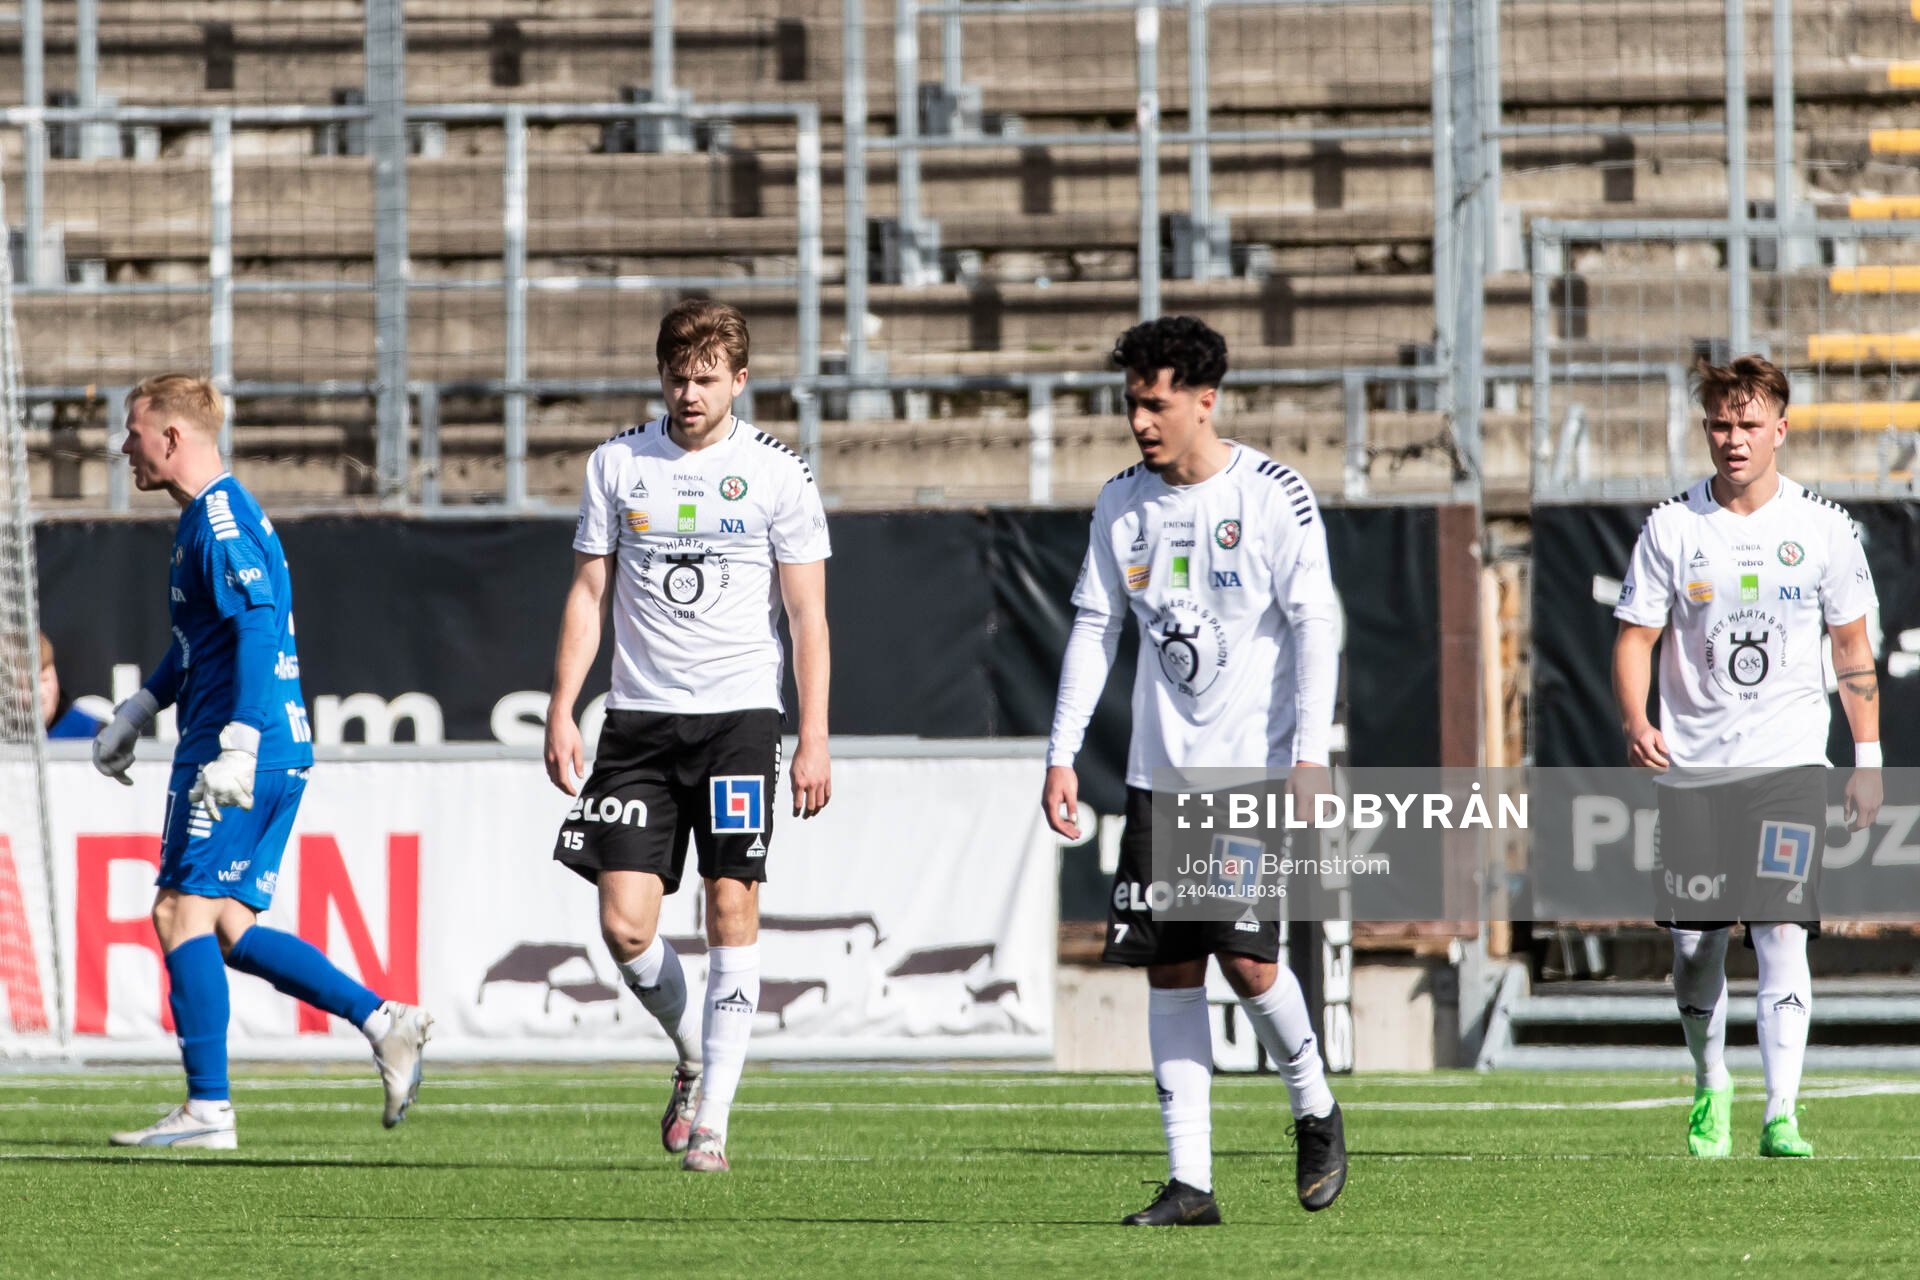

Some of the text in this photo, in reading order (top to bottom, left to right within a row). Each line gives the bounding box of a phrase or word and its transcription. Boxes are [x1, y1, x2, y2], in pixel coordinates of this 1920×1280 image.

[719, 518, 746, 534] NA
[1212, 571, 1242, 588] NA
[1779, 585, 1801, 600] NA
[673, 610, 696, 619] 1908
[561, 830, 585, 850] 15
[1113, 923, 1130, 944] 7
